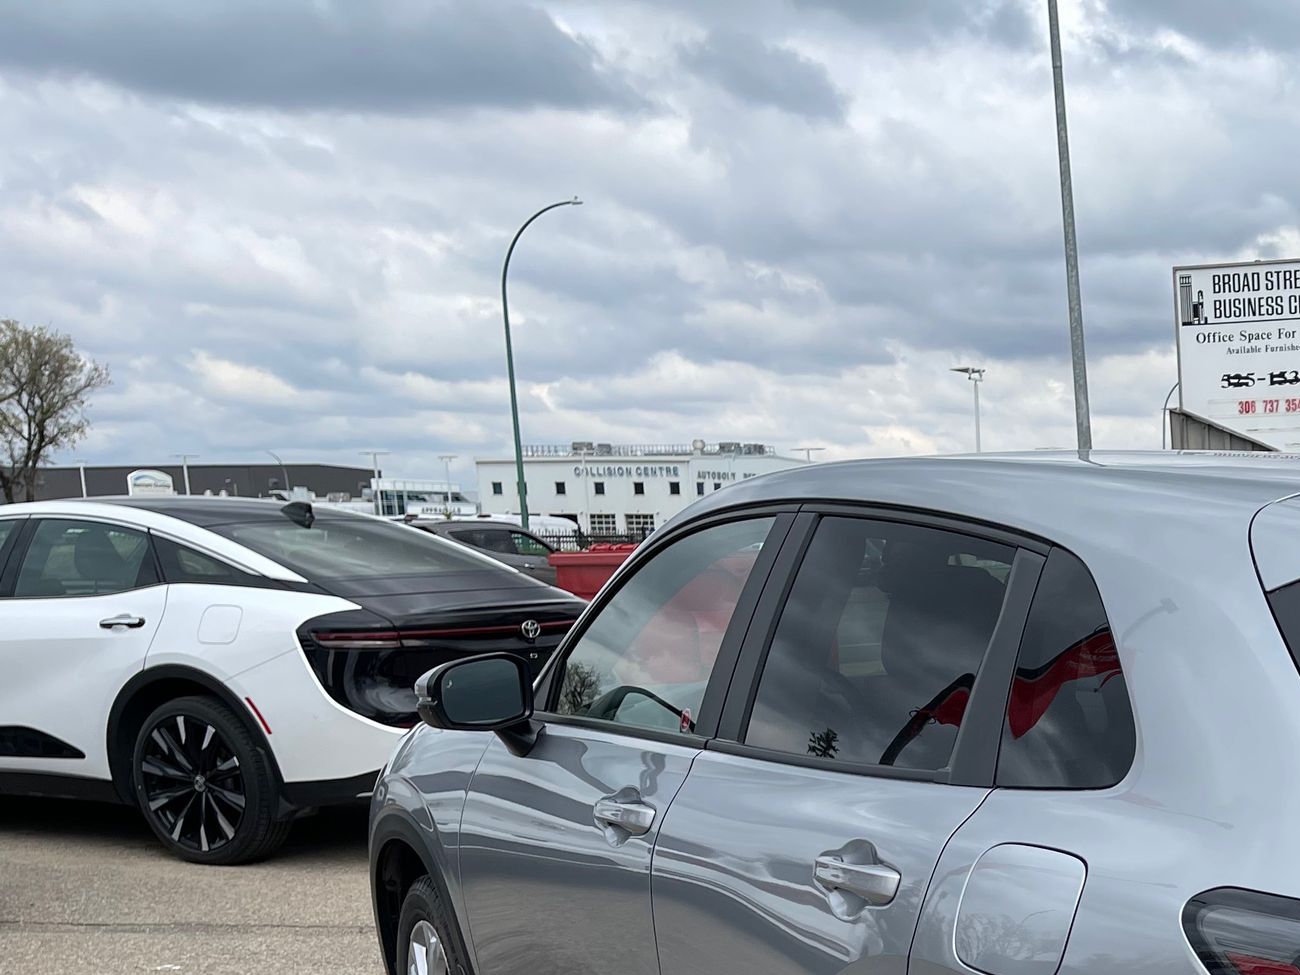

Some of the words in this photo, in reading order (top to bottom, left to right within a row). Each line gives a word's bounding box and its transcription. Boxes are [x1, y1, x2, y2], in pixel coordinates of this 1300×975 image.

[1212, 272, 1260, 294] BROAD
[1214, 295, 1284, 319] BUSINESS
[1196, 331, 1234, 344] Office
[1239, 330, 1272, 342] Space
[1278, 328, 1297, 339] For
[1226, 346, 1261, 355] Available
[1238, 400, 1257, 414] 306
[1262, 399, 1279, 413] 737
[574, 466, 632, 478] COLLISION
[635, 466, 680, 478] CENTRE
